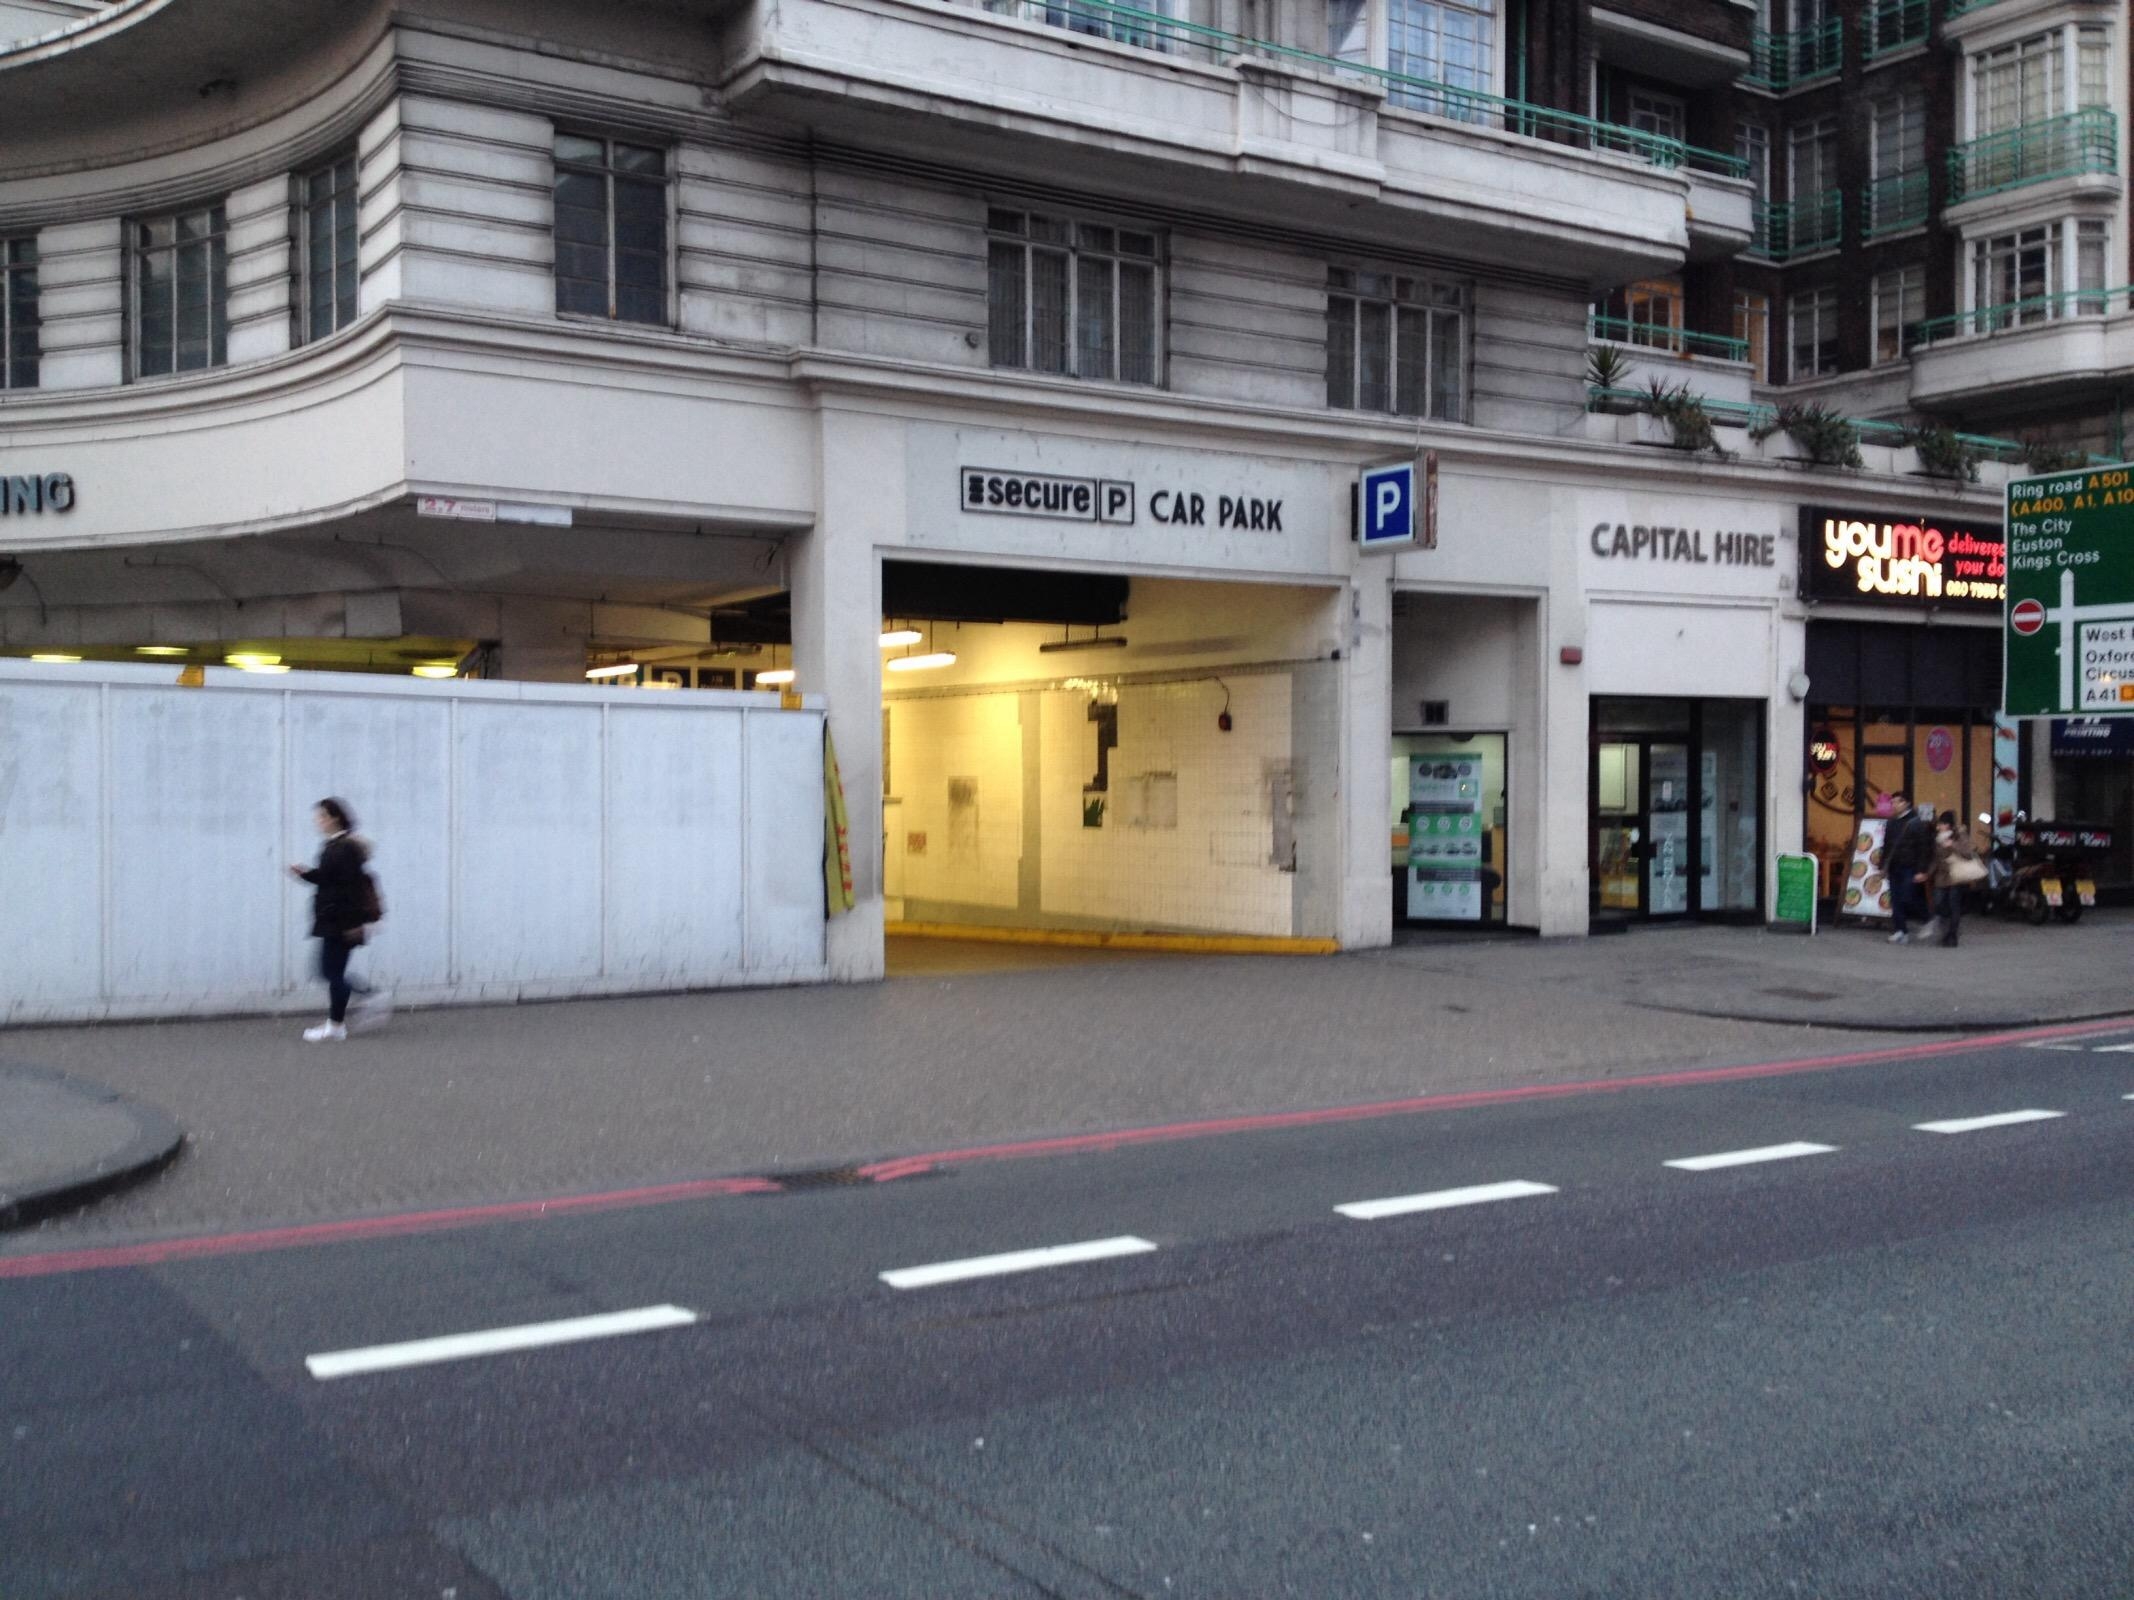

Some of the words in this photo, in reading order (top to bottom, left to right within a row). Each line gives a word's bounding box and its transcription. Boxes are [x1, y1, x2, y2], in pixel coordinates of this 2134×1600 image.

[2012, 484, 2044, 499] Ring
[2049, 477, 2083, 494] road
[987, 477, 1090, 513] secure
[1108, 487, 1127, 516] P
[1149, 489, 1206, 526] CAR
[1218, 494, 1283, 532] PARK
[1376, 480, 1402, 531] P
[2012, 522, 2038, 537] The
[2042, 517, 2072, 535] City
[1590, 522, 1708, 564] CAPITAL
[1714, 530, 1776, 567] HIRE
[2012, 537, 2063, 554] Euston
[1954, 561, 1984, 577] your
[2012, 555, 2052, 571] Kings
[2057, 550, 2100, 566] Cross
[1857, 555, 1942, 598] sushi
[2086, 627, 2125, 641] West
